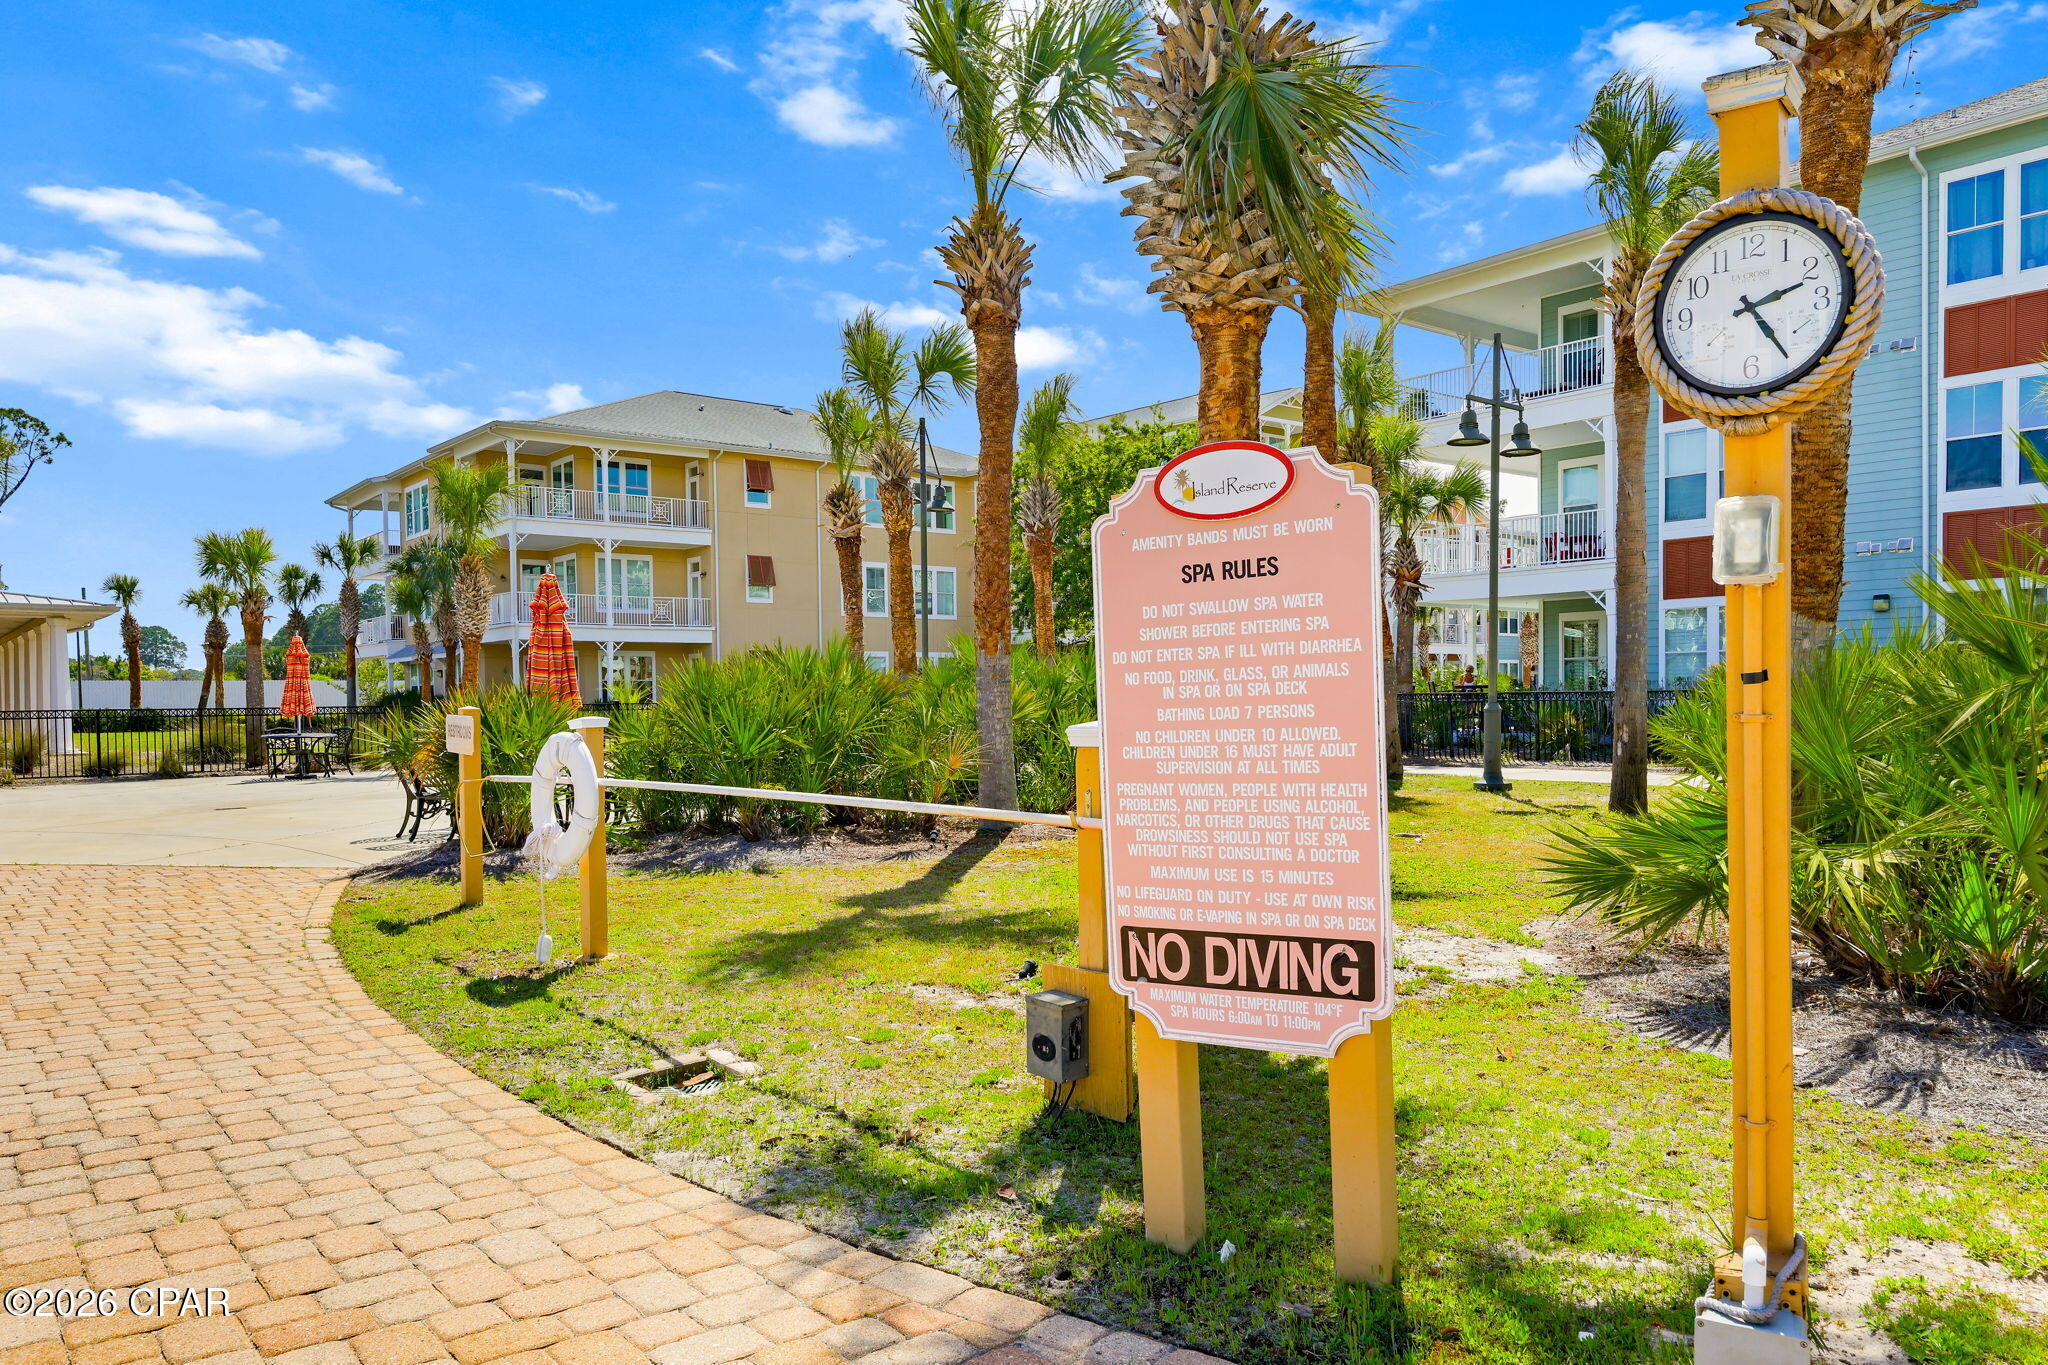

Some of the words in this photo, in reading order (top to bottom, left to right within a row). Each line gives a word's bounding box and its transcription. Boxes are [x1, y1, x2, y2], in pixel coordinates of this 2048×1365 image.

[1739, 234, 1766, 260] 12
[1781, 238, 1790, 262] 1
[1711, 250, 1730, 274] 11
[1803, 257, 1819, 282] 2
[1687, 276, 1709, 300] 10
[1814, 286, 1830, 311] 3
[1678, 308, 1693, 331] 9
[1743, 356, 1760, 379] 6
[1192, 482, 1225, 499] Island
[1226, 477, 1277, 494] Reserve
[1132, 535, 1184, 552] AMENITY
[1187, 530, 1228, 546] BANDS
[1233, 526, 1268, 542] MUST
[1274, 522, 1289, 536] BE
[1294, 517, 1333, 534] WORN
[1181, 563, 1215, 583] SPA
[1222, 556, 1279, 580] RULES
[1142, 606, 1158, 619] DO
[1162, 604, 1184, 618] NOT
[1189, 598, 1249, 616] SWALLOW
[1254, 596, 1278, 611] SPA
[1282, 593, 1324, 608] WATER
[1139, 625, 1188, 641] SHOWER
[1192, 622, 1236, 638] BEFORE
[1241, 618, 1300, 634] ENTERING
[1306, 616, 1330, 630] SPA
[1112, 652, 1127, 664] DO
[1131, 650, 1152, 664] NOT
[1156, 648, 1193, 662] ENTER
[1197, 645, 1220, 660] SPA
[1224, 645, 1235, 658] IF
[1239, 644, 1256, 657] ILL
[1261, 642, 1295, 656] WITH
[1300, 638, 1362, 655] DIARRHEA
[1124, 672, 1140, 686] NO
[1144, 671, 1175, 686] FOOD,
[1180, 669, 1219, 684] DRINK,
[1223, 667, 1267, 682] GLASS,
[1272, 665, 1288, 678] OR
[1293, 662, 1349, 678] ANIMALS
[1163, 686, 1174, 699] IN
[1178, 685, 1200, 699] SPA
[1204, 685, 1221, 698] OR
[1225, 684, 1242, 697] ON
[1247, 683, 1271, 696] SPA
[1275, 681, 1307, 695] DECK
[1157, 707, 1204, 722] BATHING
[1209, 706, 1240, 720] LOAD
[1245, 706, 1253, 719] 7
[1258, 704, 1315, 718] PERSONS
[1135, 731, 1150, 744] NO
[1154, 729, 1210, 744] CHILDREN
[1215, 728, 1256, 742] UNDER
[1262, 728, 1276, 742] 10
[1280, 727, 1341, 741] ALLOWED.
[1122, 746, 1175, 760] CHILDREN
[1180, 745, 1218, 758] UNDER
[1225, 744, 1238, 758] 16
[1242, 744, 1278, 758] MUST
[1283, 743, 1314, 758] HAVE
[1319, 742, 1358, 757] ADULT
[1156, 760, 1232, 774] SUPERVISION
[1237, 760, 1251, 774] AT
[1256, 760, 1278, 774] ALL
[1283, 760, 1320, 774] TIMES
[1117, 784, 1174, 796] PREGNANT
[1178, 783, 1228, 798] WOMEN,
[1232, 783, 1278, 797] PEOPLE
[1282, 783, 1316, 797] WITH
[1320, 783, 1367, 797] HEALTH
[1119, 799, 1180, 813] PROBLEMS,
[1184, 798, 1209, 812] AND
[1213, 799, 1258, 812] PEOPLE
[1264, 799, 1300, 813] USING
[1305, 799, 1364, 815] ALCOHOL,
[1116, 813, 1180, 828] NARCOTICS,
[1184, 814, 1200, 828] OR
[1205, 814, 1244, 828] OTHER
[1248, 815, 1290, 829] DRUGS
[1294, 816, 1325, 830] THAT
[1330, 816, 1370, 831] CAUSE
[1136, 828, 1208, 844] DROWSINESS
[1213, 830, 1260, 845] SHOULD
[1266, 831, 1290, 846] NOT
[1295, 832, 1319, 846] USE
[1324, 832, 1348, 847] SPA
[1128, 843, 1178, 858] WITHOUT
[1181, 845, 1214, 860] FIRST
[1218, 846, 1292, 861] CONSULTING
[1297, 848, 1306, 861] A
[1310, 848, 1360, 864] DOCTOR
[1150, 866, 1210, 882] MAXIMUM
[1214, 868, 1238, 882] USE
[1242, 869, 1254, 883] IS
[1260, 870, 1274, 884] 15
[1278, 870, 1334, 886] MINUTES
[1116, 886, 1131, 898] NO
[1135, 886, 1192, 902] LIFEGUARD
[1197, 890, 1214, 903] ON
[1218, 891, 1252, 905] DUTY
[1264, 892, 1288, 907] USE
[1292, 894, 1308, 907] AT
[1312, 894, 1342, 909] OWN
[1347, 896, 1376, 911] RISK
[1118, 904, 1131, 917] NO
[1133, 905, 1176, 921] SMOKING
[1179, 908, 1194, 921] OR
[1198, 909, 1242, 924] E-VAPING
[1246, 911, 1257, 925] IN
[1261, 912, 1282, 926] SPA
[1286, 913, 1300, 926] OR
[1304, 914, 1320, 928] ON
[1324, 915, 1344, 930] SPA
[1348, 916, 1376, 932] DECK
[1128, 930, 1190, 982] NO
[1204, 936, 1359, 996] DIVING
[1150, 988, 1197, 1004] MAXIMUM
[1200, 992, 1232, 1008] WATER
[1236, 995, 1309, 1014] TEMPERATURE
[1314, 1002, 1343, 1018] 104°F
[1170, 1004, 1188, 1018] SPA
[1192, 1006, 1225, 1022] HOURS
[1265, 1013, 1279, 1026] TO
